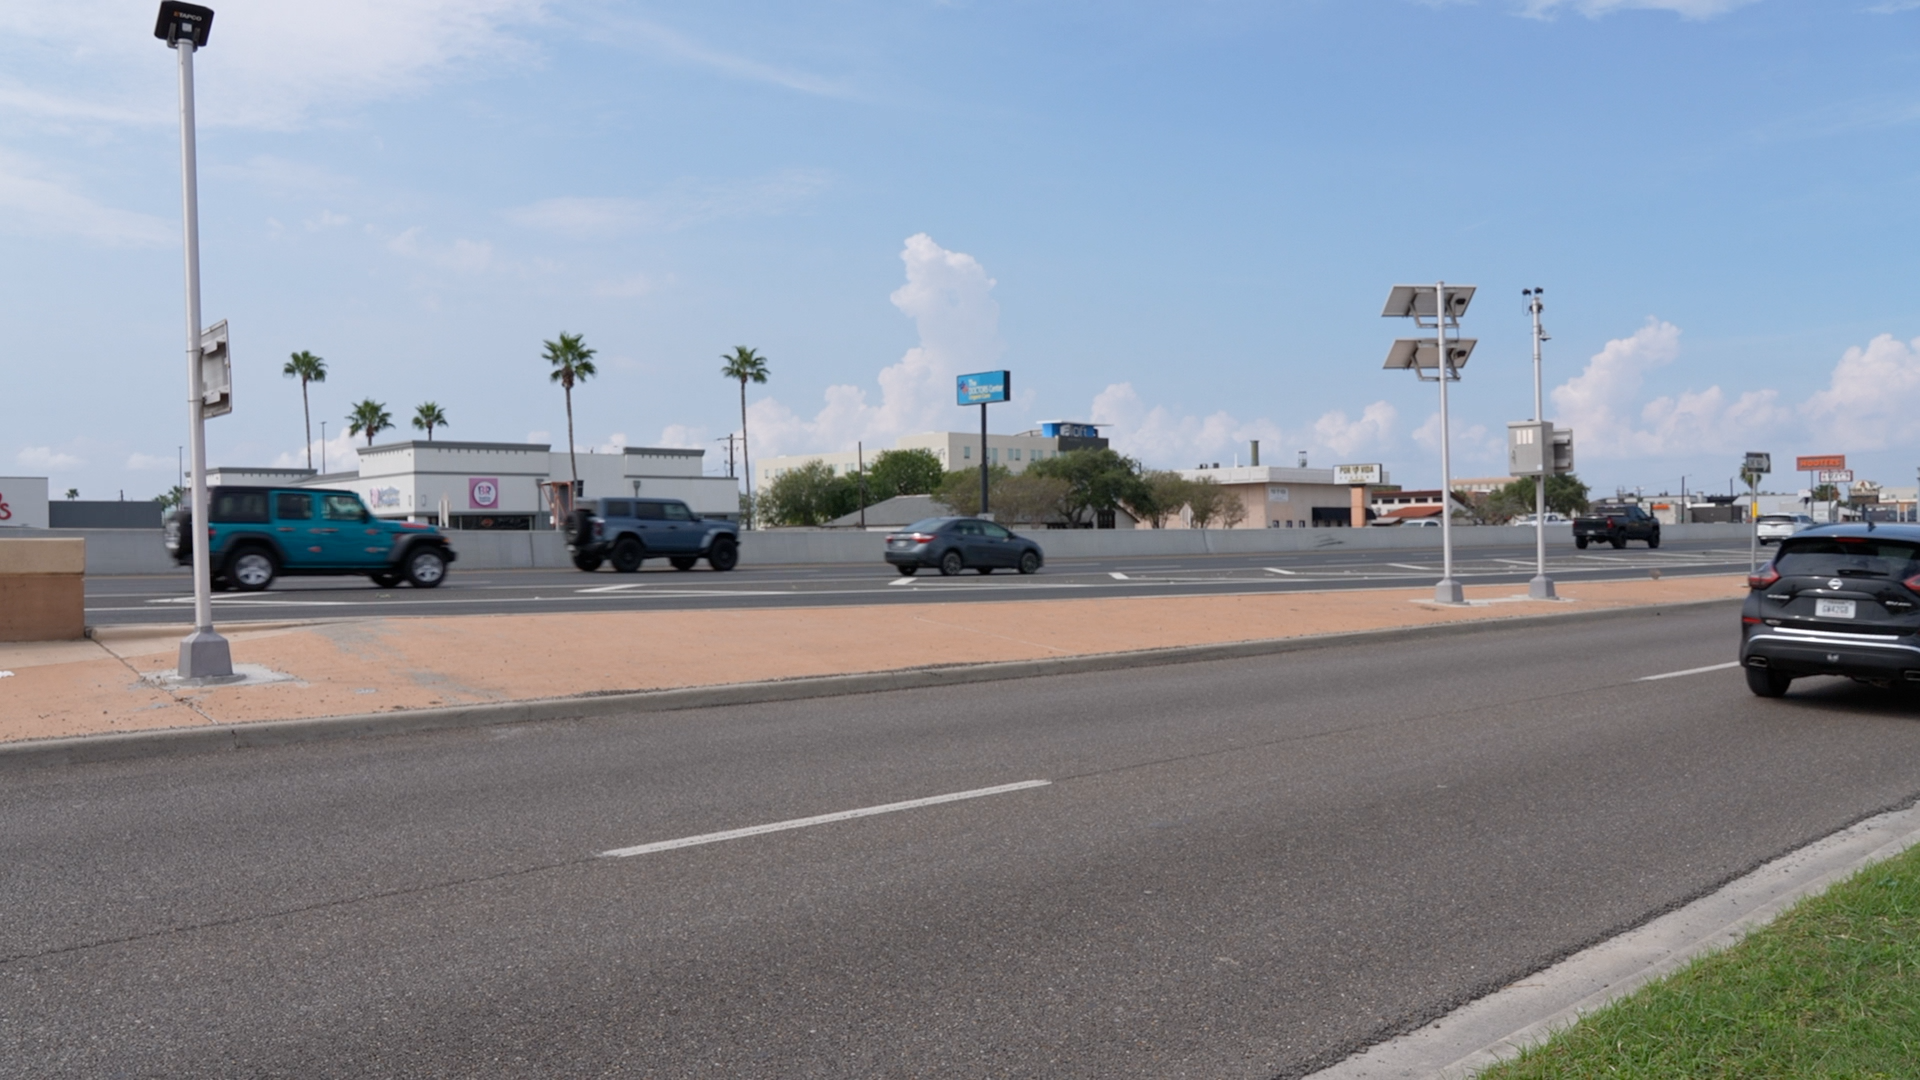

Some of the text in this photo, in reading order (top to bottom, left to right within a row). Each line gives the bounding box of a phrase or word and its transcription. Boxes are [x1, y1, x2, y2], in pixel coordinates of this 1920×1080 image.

[179, 11, 202, 22] TAPCO
[968, 384, 1004, 394] DOCTORS Center
[1800, 459, 1841, 467] HOOTERS
